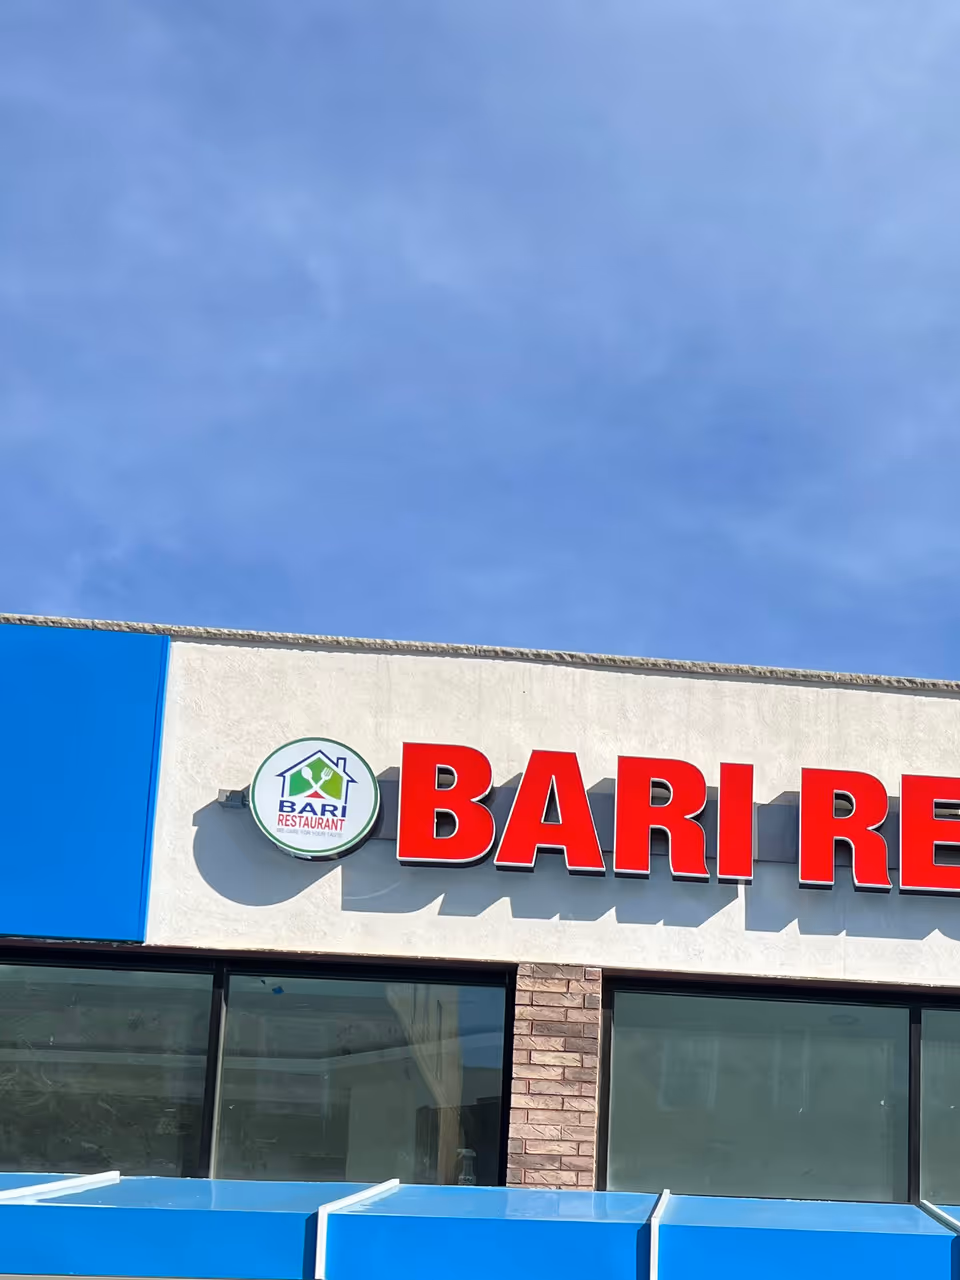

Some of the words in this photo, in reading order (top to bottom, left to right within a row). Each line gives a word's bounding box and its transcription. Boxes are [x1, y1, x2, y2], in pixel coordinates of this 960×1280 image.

[279, 800, 347, 818] BARI
[396, 741, 754, 885] BARI
[278, 814, 345, 832] RESTAURANT
